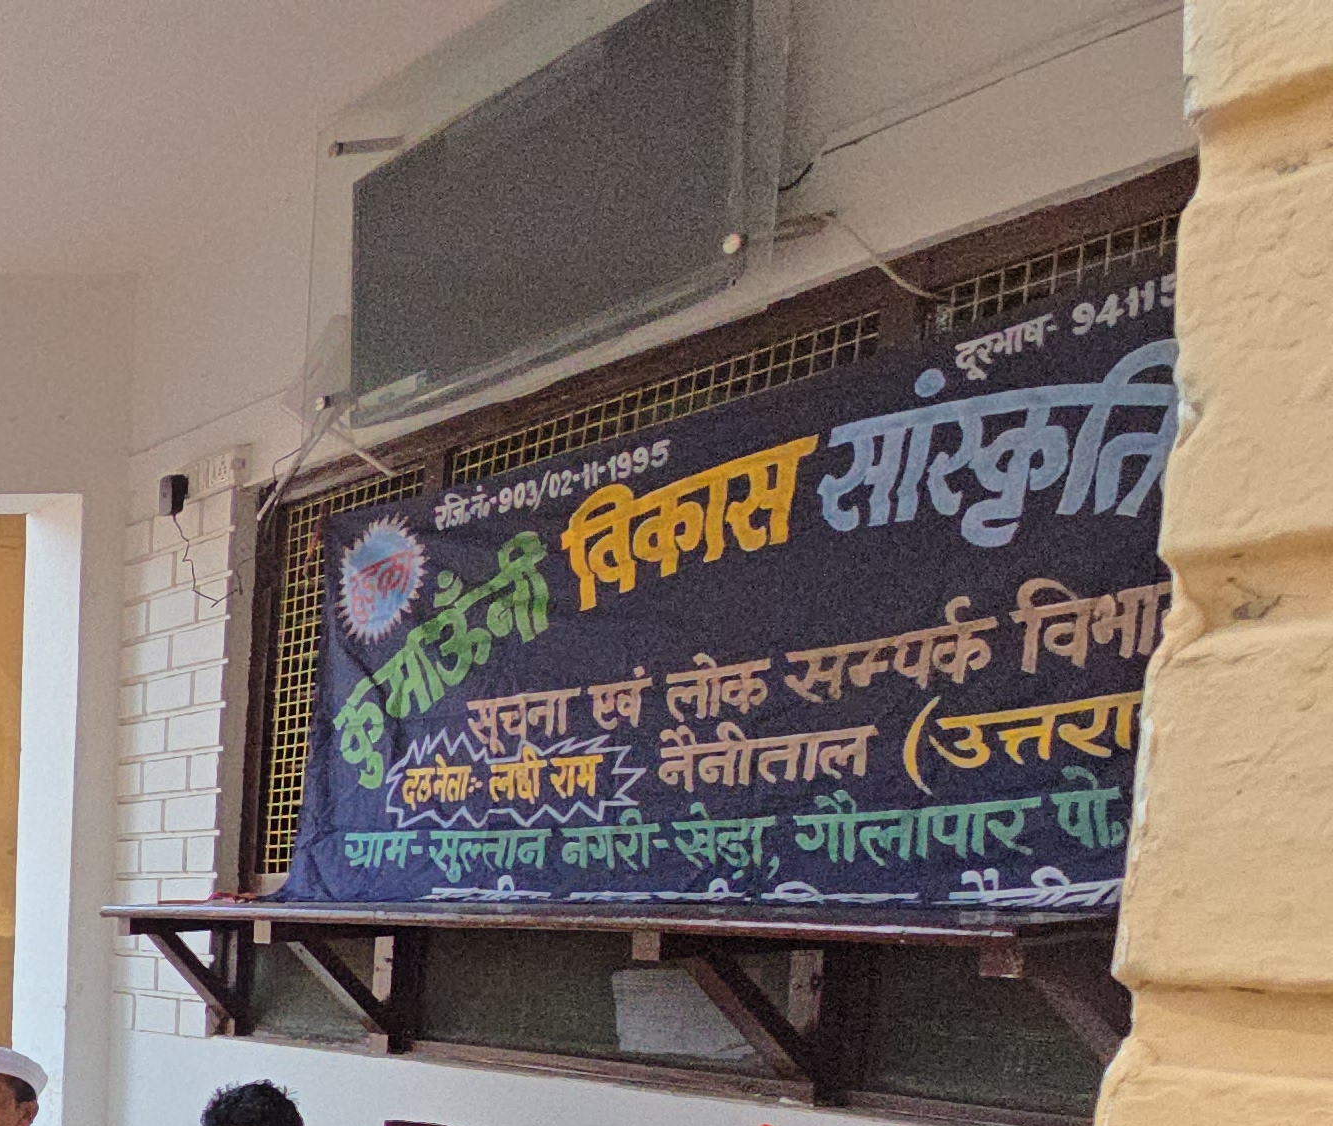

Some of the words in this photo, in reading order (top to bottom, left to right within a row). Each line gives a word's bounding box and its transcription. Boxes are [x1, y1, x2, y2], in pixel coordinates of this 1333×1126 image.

[561, 434, 820, 612] विकास
[817, 338, 1179, 547] सांस्कृति
[467, 687, 582, 756] सूचना
[587, 665, 653, 731] एवं
[666, 653, 771, 723] लोक
[786, 596, 997, 703] सम्पर्क
[1009, 577, 1172, 674] विभा
[550, 755, 604, 800] राम
[658, 721, 879, 793] नैनीताल
[792, 789, 1041, 867] गौलापार
